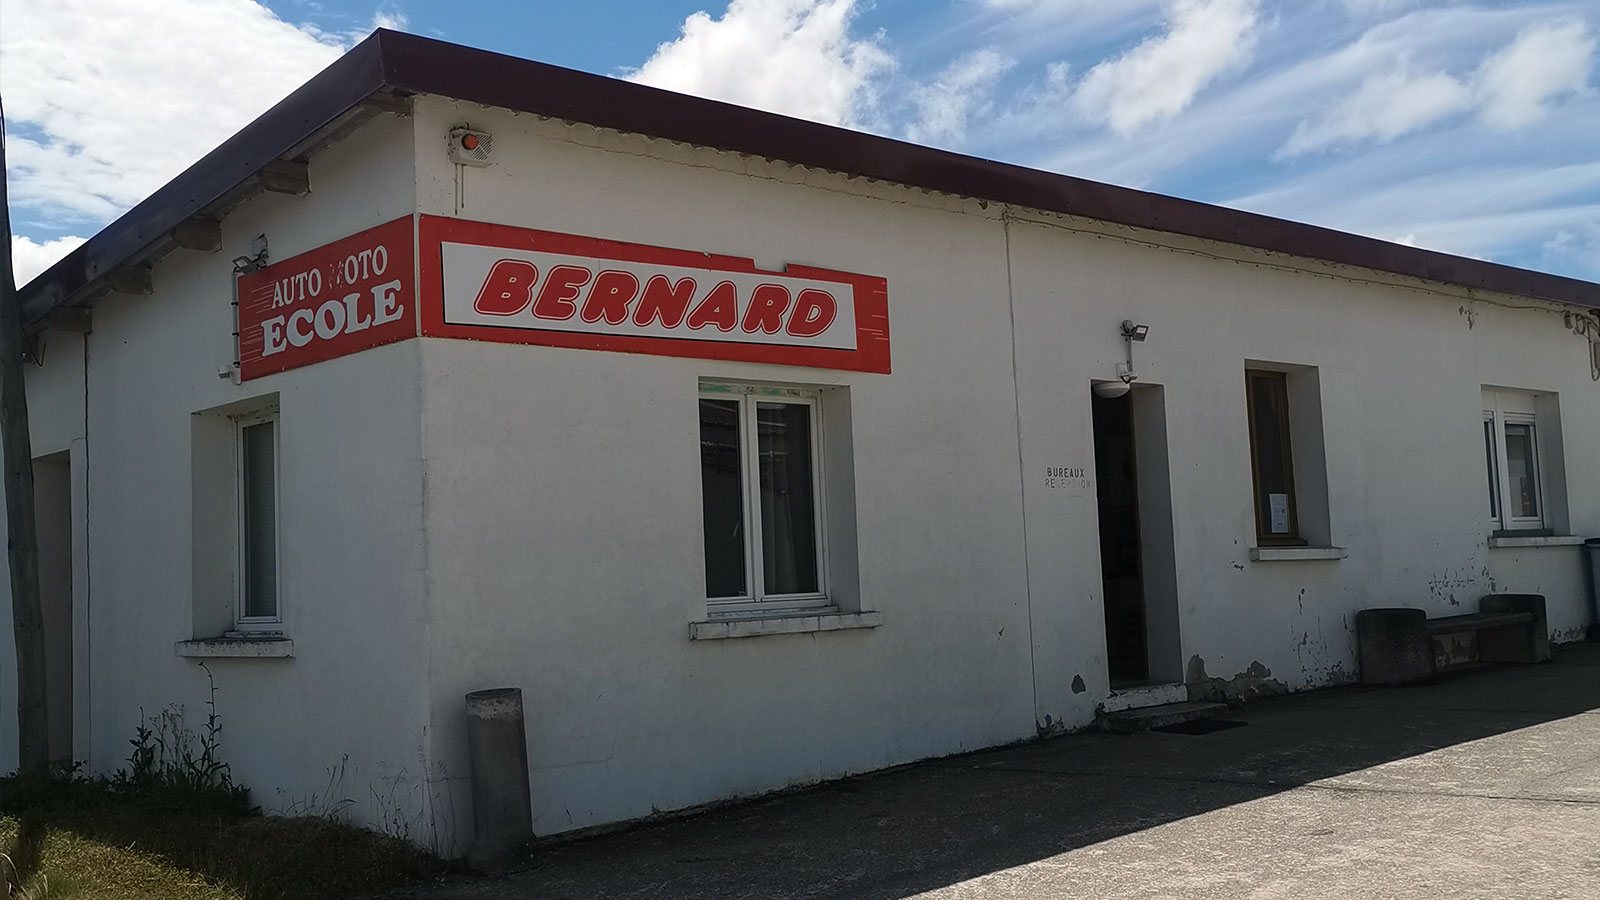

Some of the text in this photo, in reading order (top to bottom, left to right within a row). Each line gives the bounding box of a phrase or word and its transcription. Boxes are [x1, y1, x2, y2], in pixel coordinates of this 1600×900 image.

[260, 278, 405, 358] ECOLE
[271, 267, 322, 309] AUTO
[474, 258, 838, 338] BERNARD
[1046, 467, 1085, 478] BUREAUX
